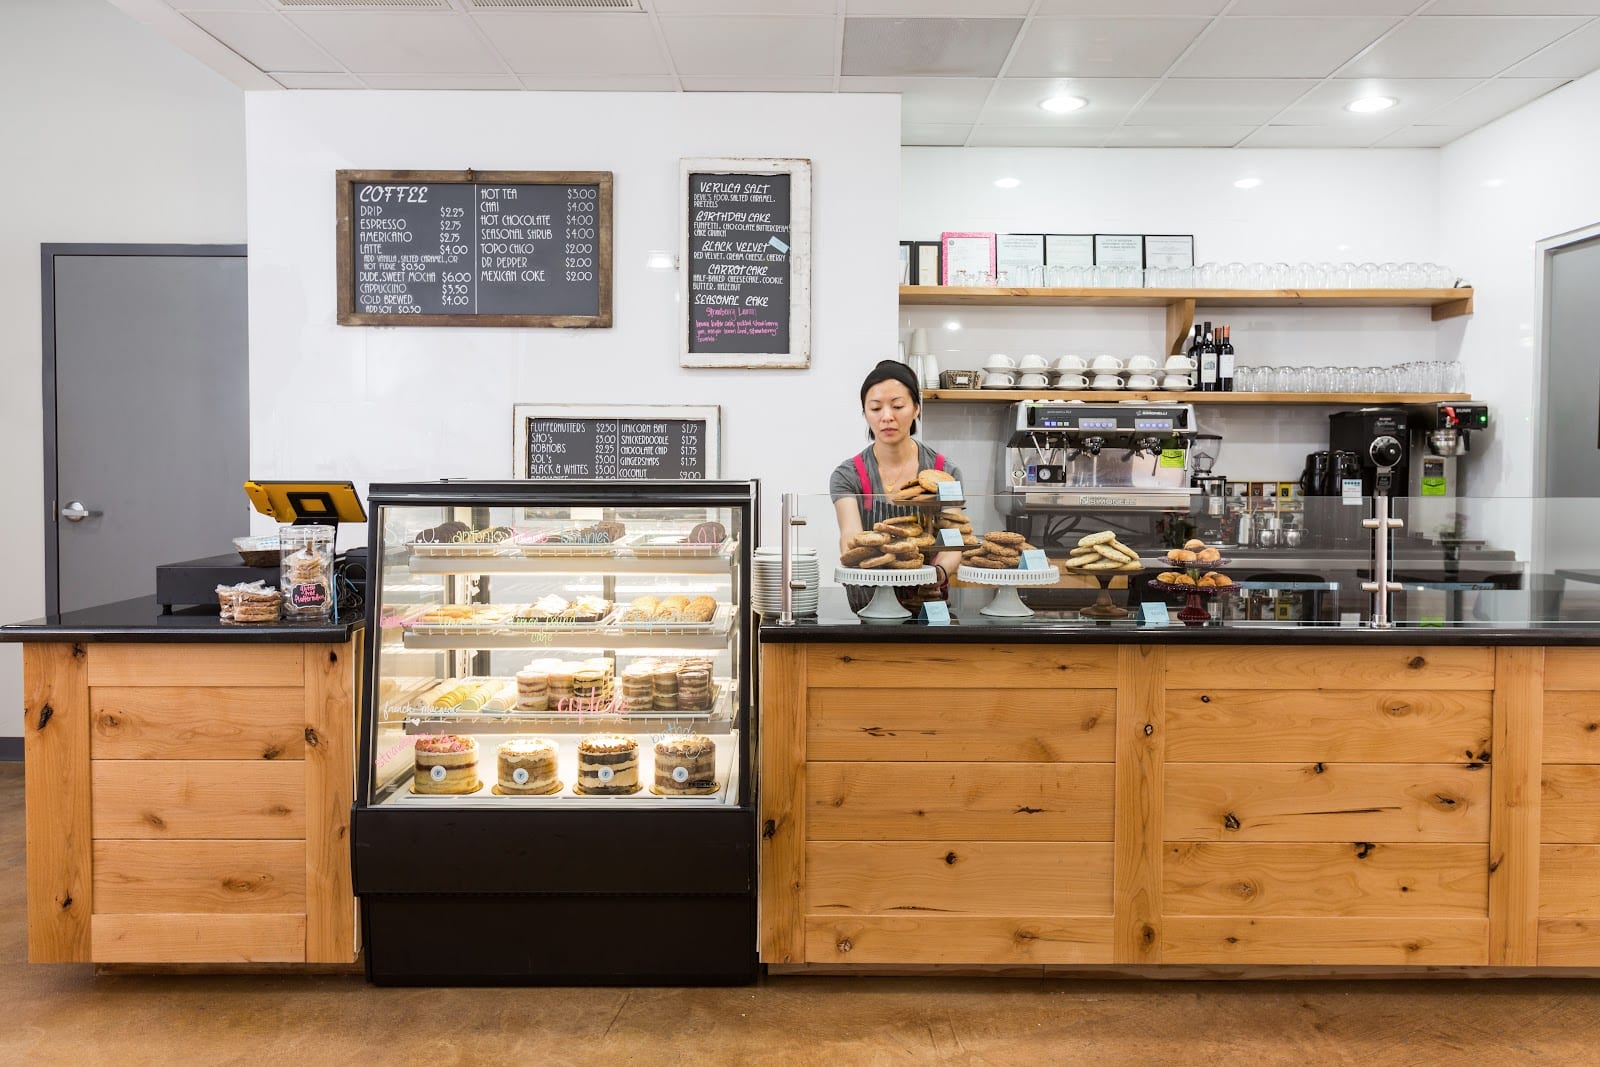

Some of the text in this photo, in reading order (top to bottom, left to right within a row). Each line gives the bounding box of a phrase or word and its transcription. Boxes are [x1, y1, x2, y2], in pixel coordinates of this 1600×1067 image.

[700, 182, 770, 194] VERUCA SALT
[360, 185, 428, 203] COFFEE
[480, 188, 596, 200] HOT TEA $3.00
[360, 206, 464, 218] DRIP $2.25
[480, 202, 594, 212] CHAI $4.00
[480, 215, 594, 226] HOT CHOCOLATE $4.00
[696, 211, 771, 222] BIRTHDAY CAKE
[360, 218, 462, 231] ESPRESSO $2.75
[360, 232, 460, 243] AMERICANO $2.75
[482, 228, 594, 240] SEASONAL SHRUB $4.00
[360, 244, 468, 255] LATTE $4.00
[480, 243, 592, 254] TOPO CHICO $2.00
[702, 240, 770, 252] BLACK VELVET
[401, 262, 426, 271] $0.50
[481, 257, 592, 268] DR PEPPER $2.00
[708, 264, 768, 276] CARROT CAKE
[382, 272, 405, 282] SWEET
[408, 272, 436, 282] MOCHA
[442, 272, 472, 283] $6.00
[481, 270, 592, 282] MEXICAN COKE $2.00
[762, 276, 784, 284] COOKIE
[360, 284, 406, 294] CAPPUCCINO
[360, 294, 468, 306] COLD BREWED $4.00
[694, 294, 768, 306] SEASONAL CAKE
[378, 306, 392, 314] SOY
[398, 305, 421, 314] $0.50
[531, 423, 585, 432] FLUFFERNUTTERS
[622, 424, 651, 433] UNICORN
[654, 424, 667, 433] BAIT
[621, 436, 669, 444] SNICKERDOODLE
[531, 444, 566, 453] NOBNOBS
[621, 446, 697, 455] CHOCOLATE CHIP $1.75
[620, 457, 696, 466] GINGERSNAPS $1.75
[531, 464, 553, 474] BLACK
[556, 464, 561, 474] &
[564, 464, 588, 474] WHITES
[619, 469, 647, 478] COCONUT
